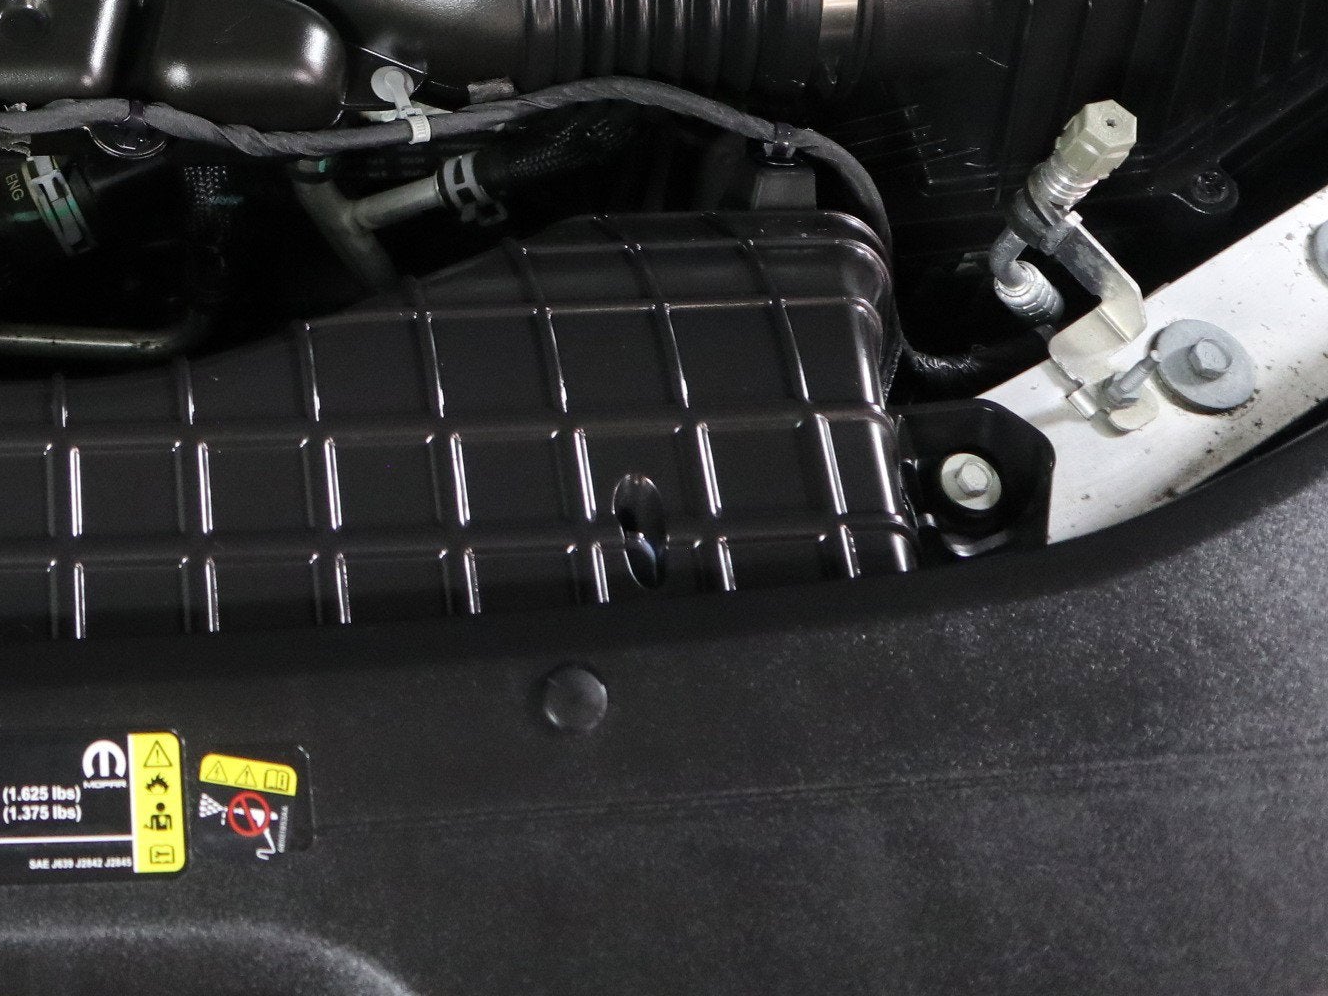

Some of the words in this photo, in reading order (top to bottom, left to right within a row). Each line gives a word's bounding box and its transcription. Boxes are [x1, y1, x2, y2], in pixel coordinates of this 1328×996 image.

[5, 173, 24, 201] ENG
[2, 786, 49, 805] (1.625
[52, 785, 82, 804] lbs)
[2, 805, 49, 824] (1.375
[52, 805, 82, 823] lbs)
[28, 858, 50, 869] SAE
